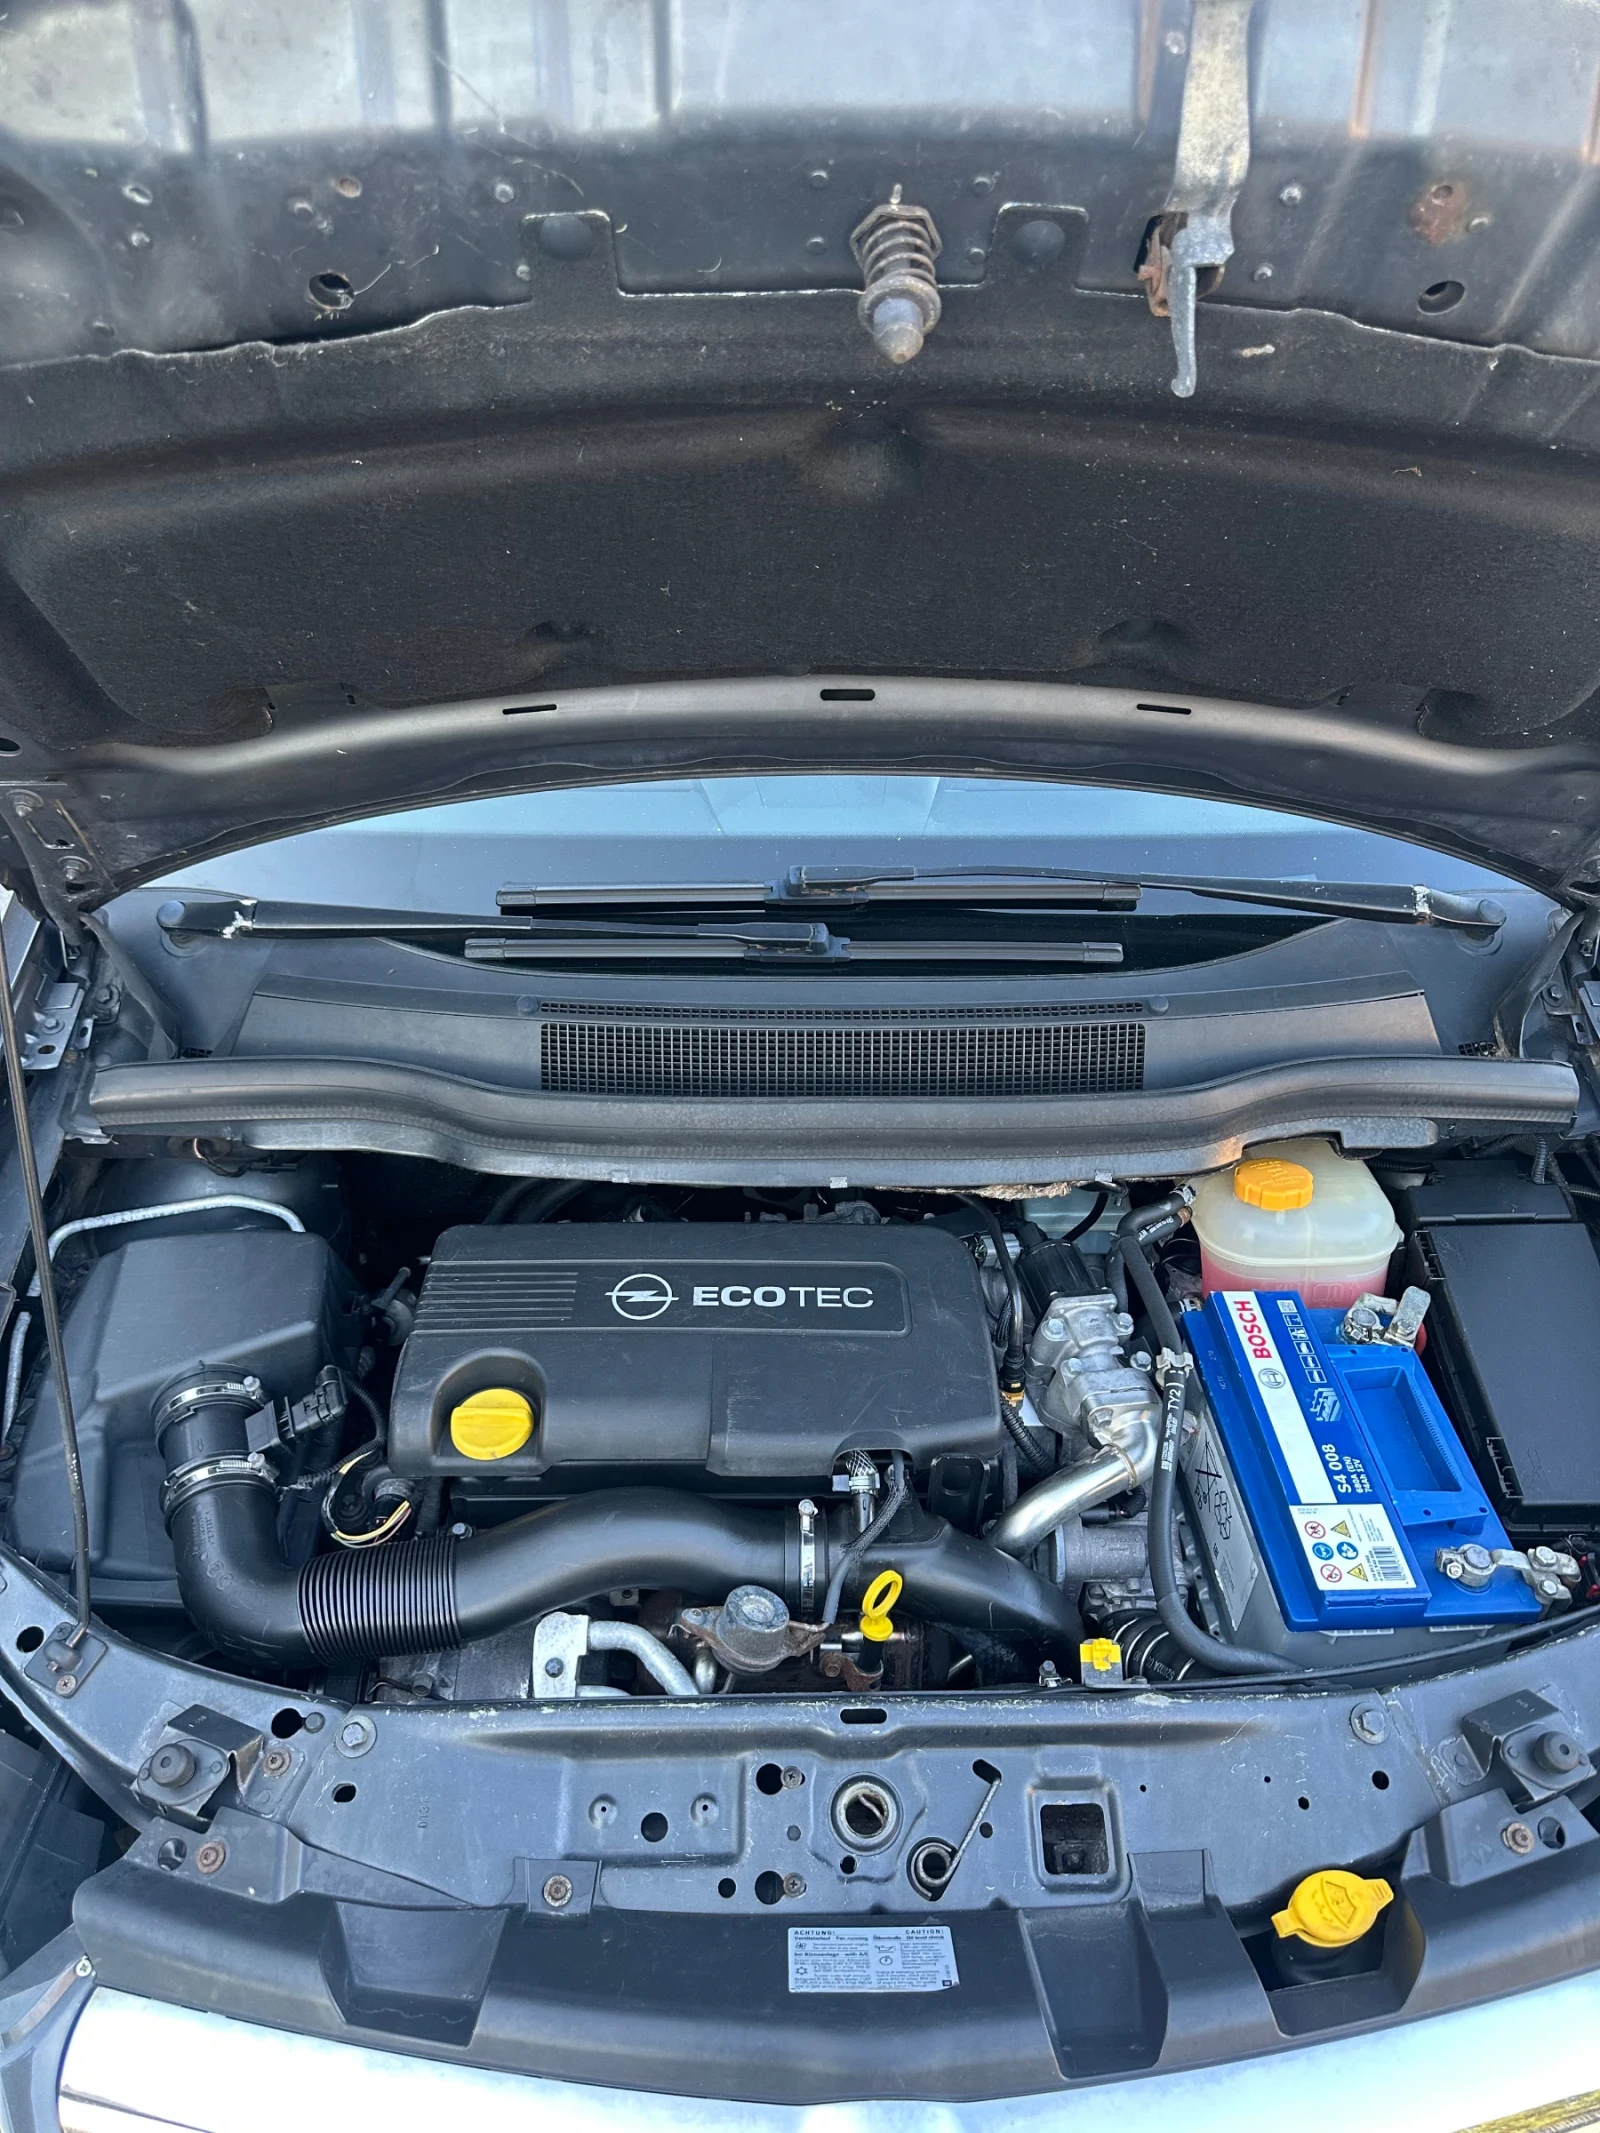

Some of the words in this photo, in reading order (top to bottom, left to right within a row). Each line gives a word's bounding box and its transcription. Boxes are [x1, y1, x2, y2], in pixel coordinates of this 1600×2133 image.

[693, 1285, 874, 1308] ECOTEC
[1233, 1301, 1272, 1358] BOSCH
[1321, 1444, 1342, 1470] 008
[1343, 1456, 1356, 1473] (EN)
[1352, 1458, 1365, 1472] 12V
[1333, 1473, 1352, 1493] S4
[1350, 1473, 1364, 1493] 680A
[1360, 1473, 1373, 1493] 74Ah
